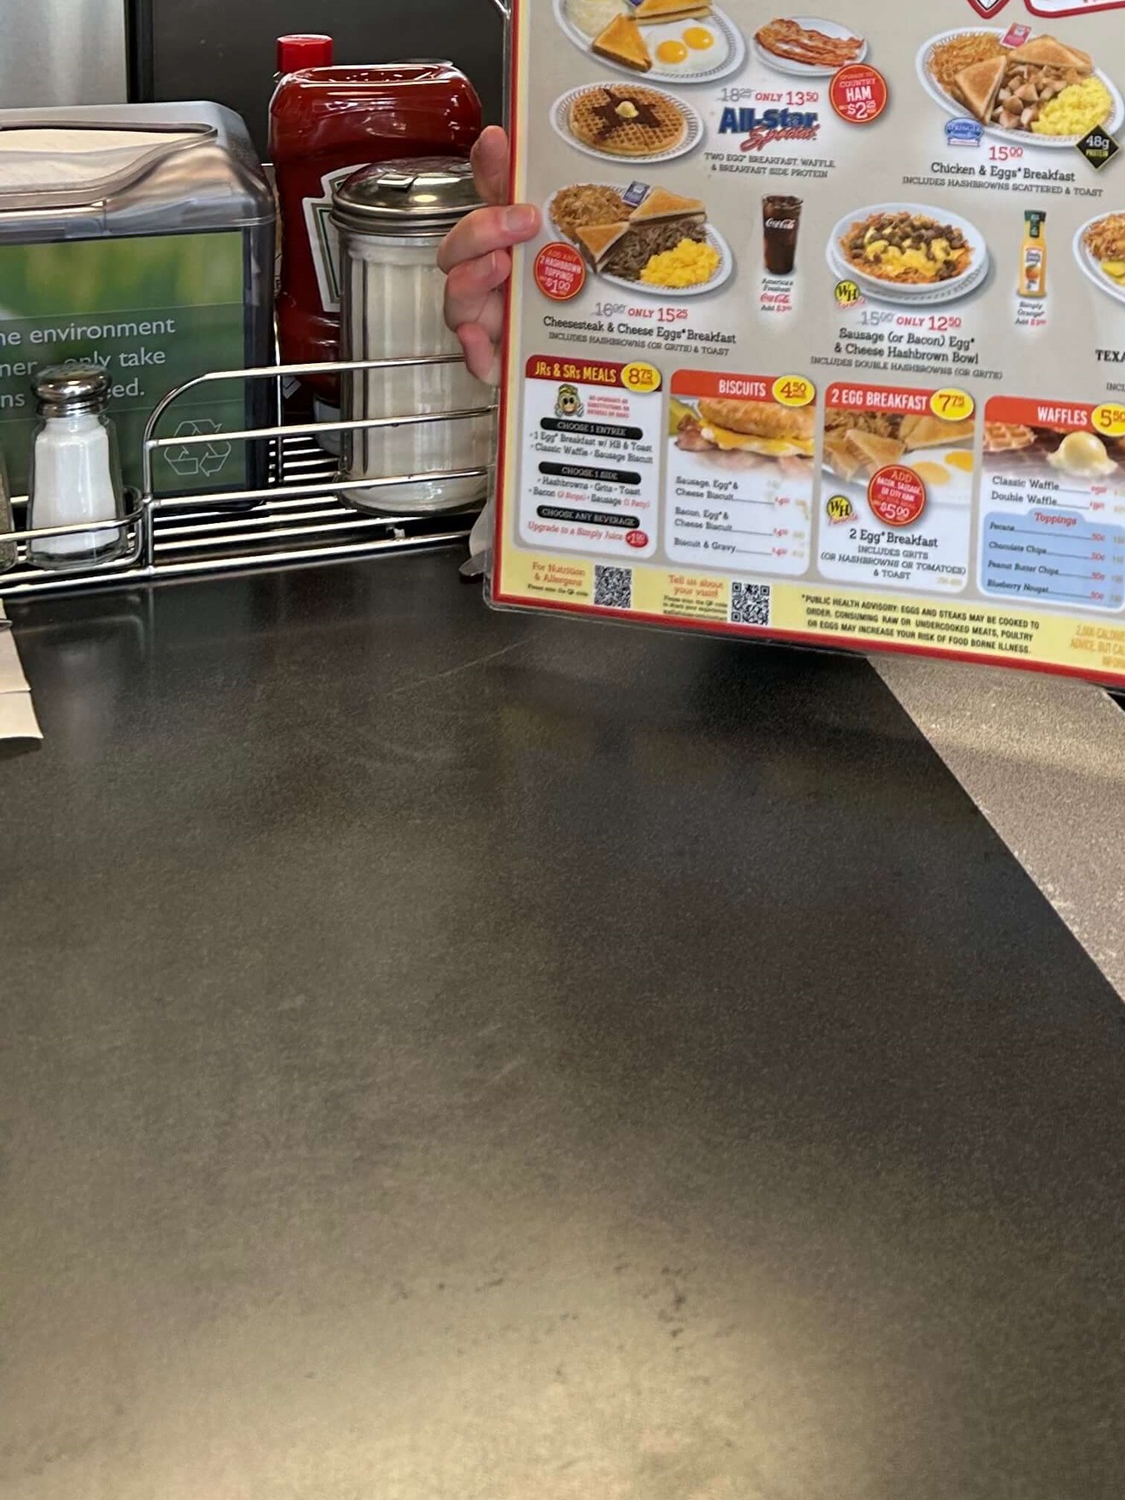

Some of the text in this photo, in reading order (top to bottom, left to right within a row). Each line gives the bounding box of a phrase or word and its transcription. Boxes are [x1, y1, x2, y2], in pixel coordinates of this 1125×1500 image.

[755, 92, 783, 102] ONLY
[845, 85, 872, 103] HAM
[718, 103, 818, 140] All-Star
[1085, 134, 1110, 150] 48g
[930, 161, 975, 176] Chicken
[979, 165, 986, 175] &
[1023, 168, 1075, 182] Breakfast
[627, 307, 653, 319] ONLY
[896, 316, 924, 328] ONLY
[30, 319, 175, 343] environment
[543, 315, 604, 332] Cheesesteak
[607, 322, 614, 332] &
[617, 323, 653, 337] Cheese
[686, 329, 736, 344] Breakfast
[838, 327, 884, 344] Sausage
[887, 331, 905, 345] (or
[907, 332, 945, 348] Bacon)
[119, 347, 166, 367] take
[834, 342, 978, 365] & Cheese Hashbrown Bowl
[535, 361, 616, 383] JRs & SRs MEALS
[718, 378, 766, 398] BISCUITS
[831, 388, 927, 411] 2 EGG BREAKFAST
[1037, 406, 1087, 426] WAFFLES
[992, 474, 1059, 491] Classic Waffle
[990, 490, 1057, 506] Double Waffle
[1034, 511, 1077, 527] Toppings
[849, 529, 857, 539] 2
[886, 532, 938, 548] Breakfast
